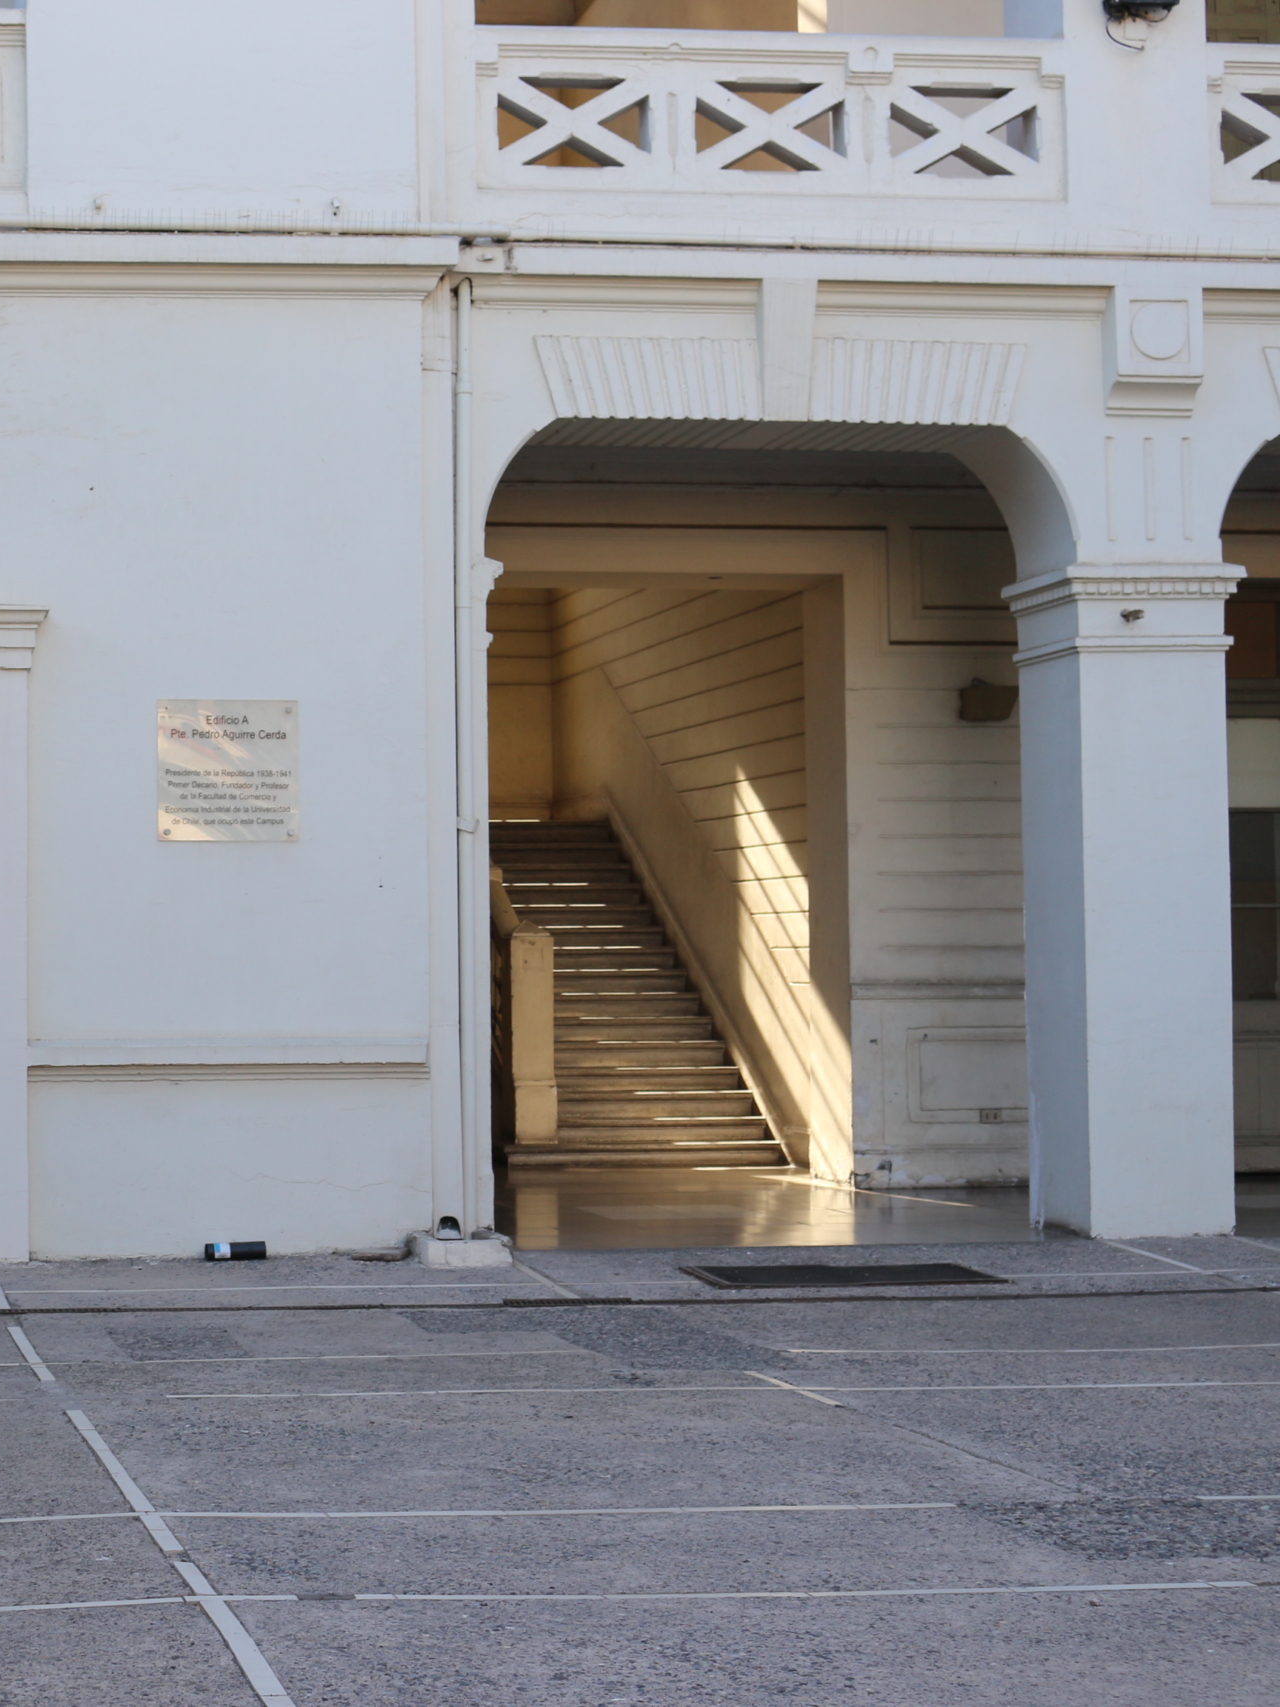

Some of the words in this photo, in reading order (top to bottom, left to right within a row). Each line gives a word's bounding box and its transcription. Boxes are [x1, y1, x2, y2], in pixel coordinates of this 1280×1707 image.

[206, 715, 240, 725] Edificio
[241, 715, 249, 725] A
[170, 728, 189, 739] Pte.
[192, 729, 220, 739] Pedro
[222, 730, 256, 741] Aguirre
[258, 730, 287, 740] Cerda
[165, 769, 201, 777] Presidente
[221, 769, 254, 779] República
[257, 770, 292, 778] 1938-1941
[182, 818, 202, 826] Chile,
[203, 818, 216, 826] que
[218, 818, 238, 826] ocupó
[256, 818, 284, 826] Campus
